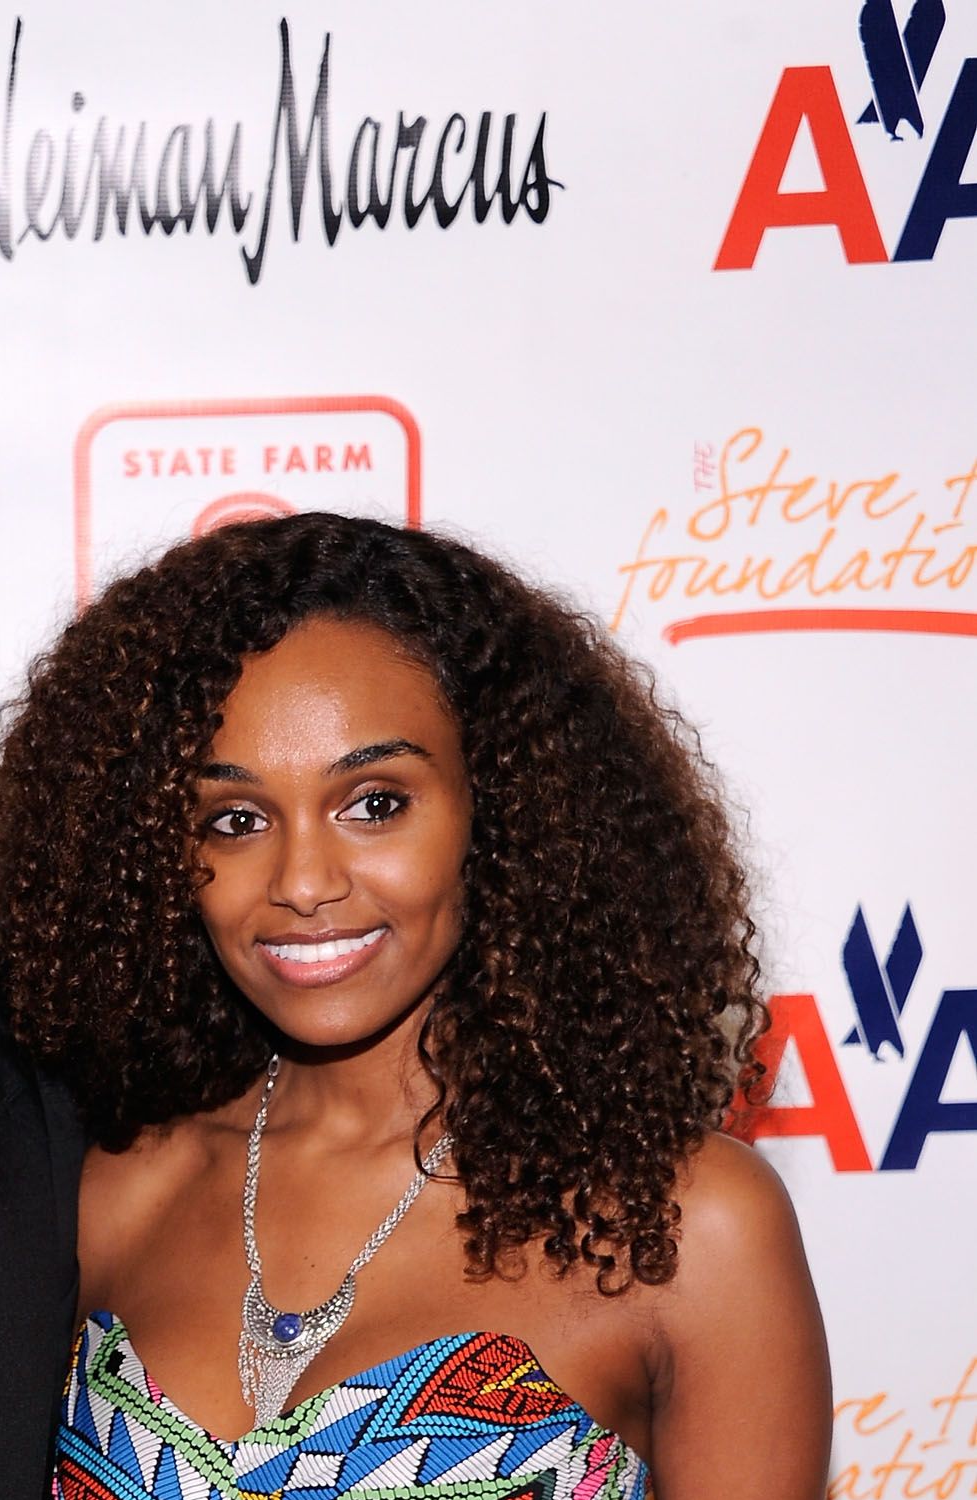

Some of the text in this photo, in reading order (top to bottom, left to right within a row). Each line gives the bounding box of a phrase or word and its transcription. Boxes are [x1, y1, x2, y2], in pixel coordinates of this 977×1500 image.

[240, 16, 566, 287] Marcus
[122, 443, 374, 480] STATE FARM
[688, 427, 918, 541] Steve
[609, 507, 977, 634] foundatio
